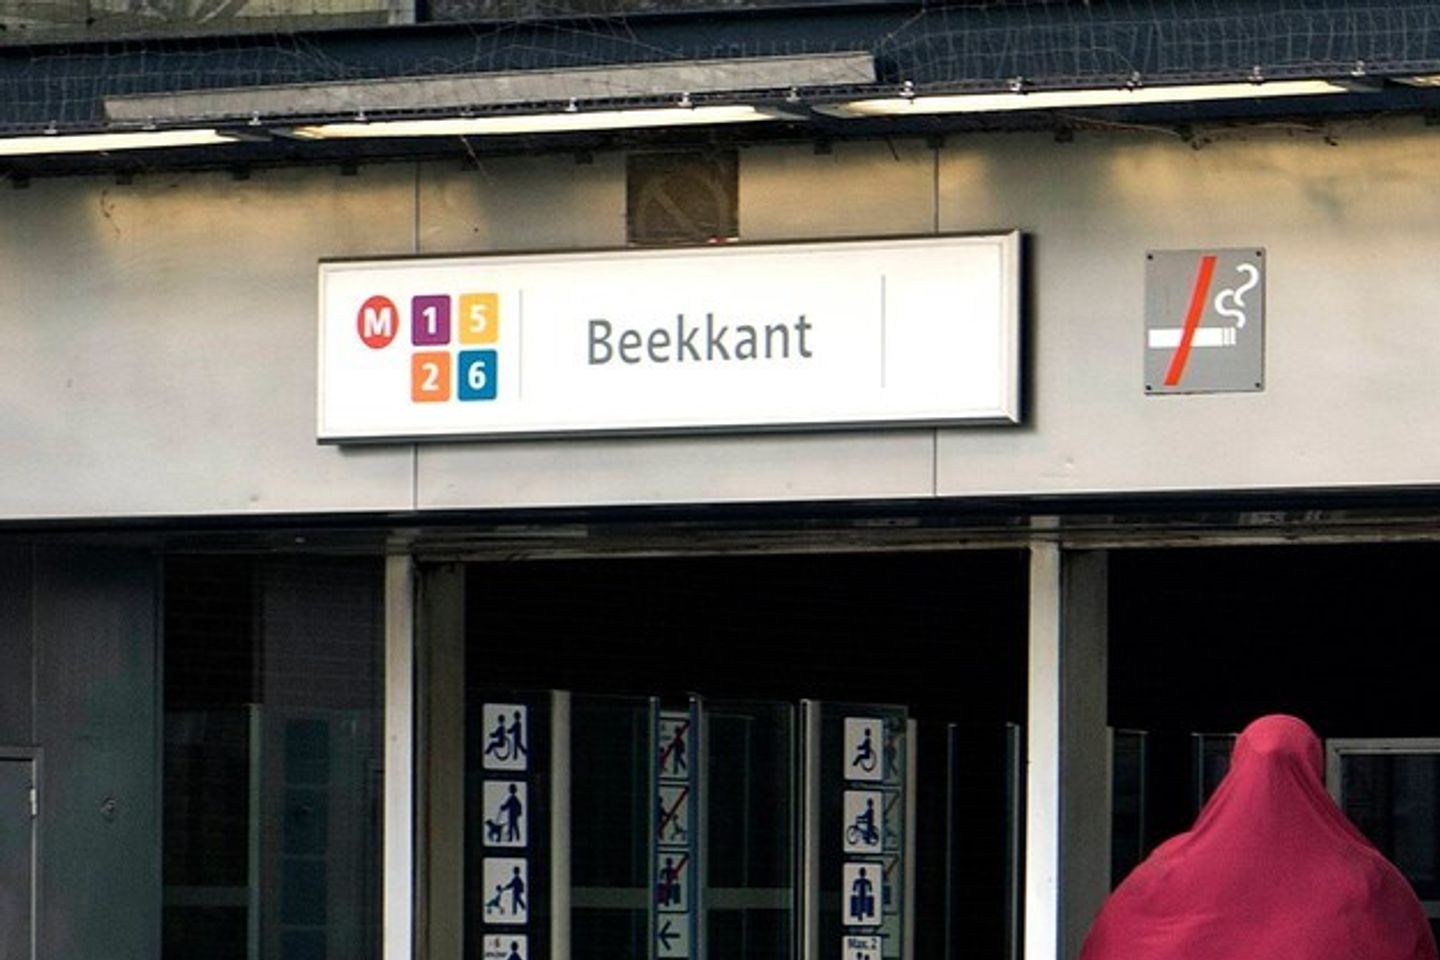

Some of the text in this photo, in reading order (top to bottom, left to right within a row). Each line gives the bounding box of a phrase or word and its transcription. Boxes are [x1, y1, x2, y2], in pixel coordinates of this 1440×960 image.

[363, 303, 488, 338] M 1 5
[587, 312, 813, 365] Beekkant
[420, 359, 487, 392] 2 6
